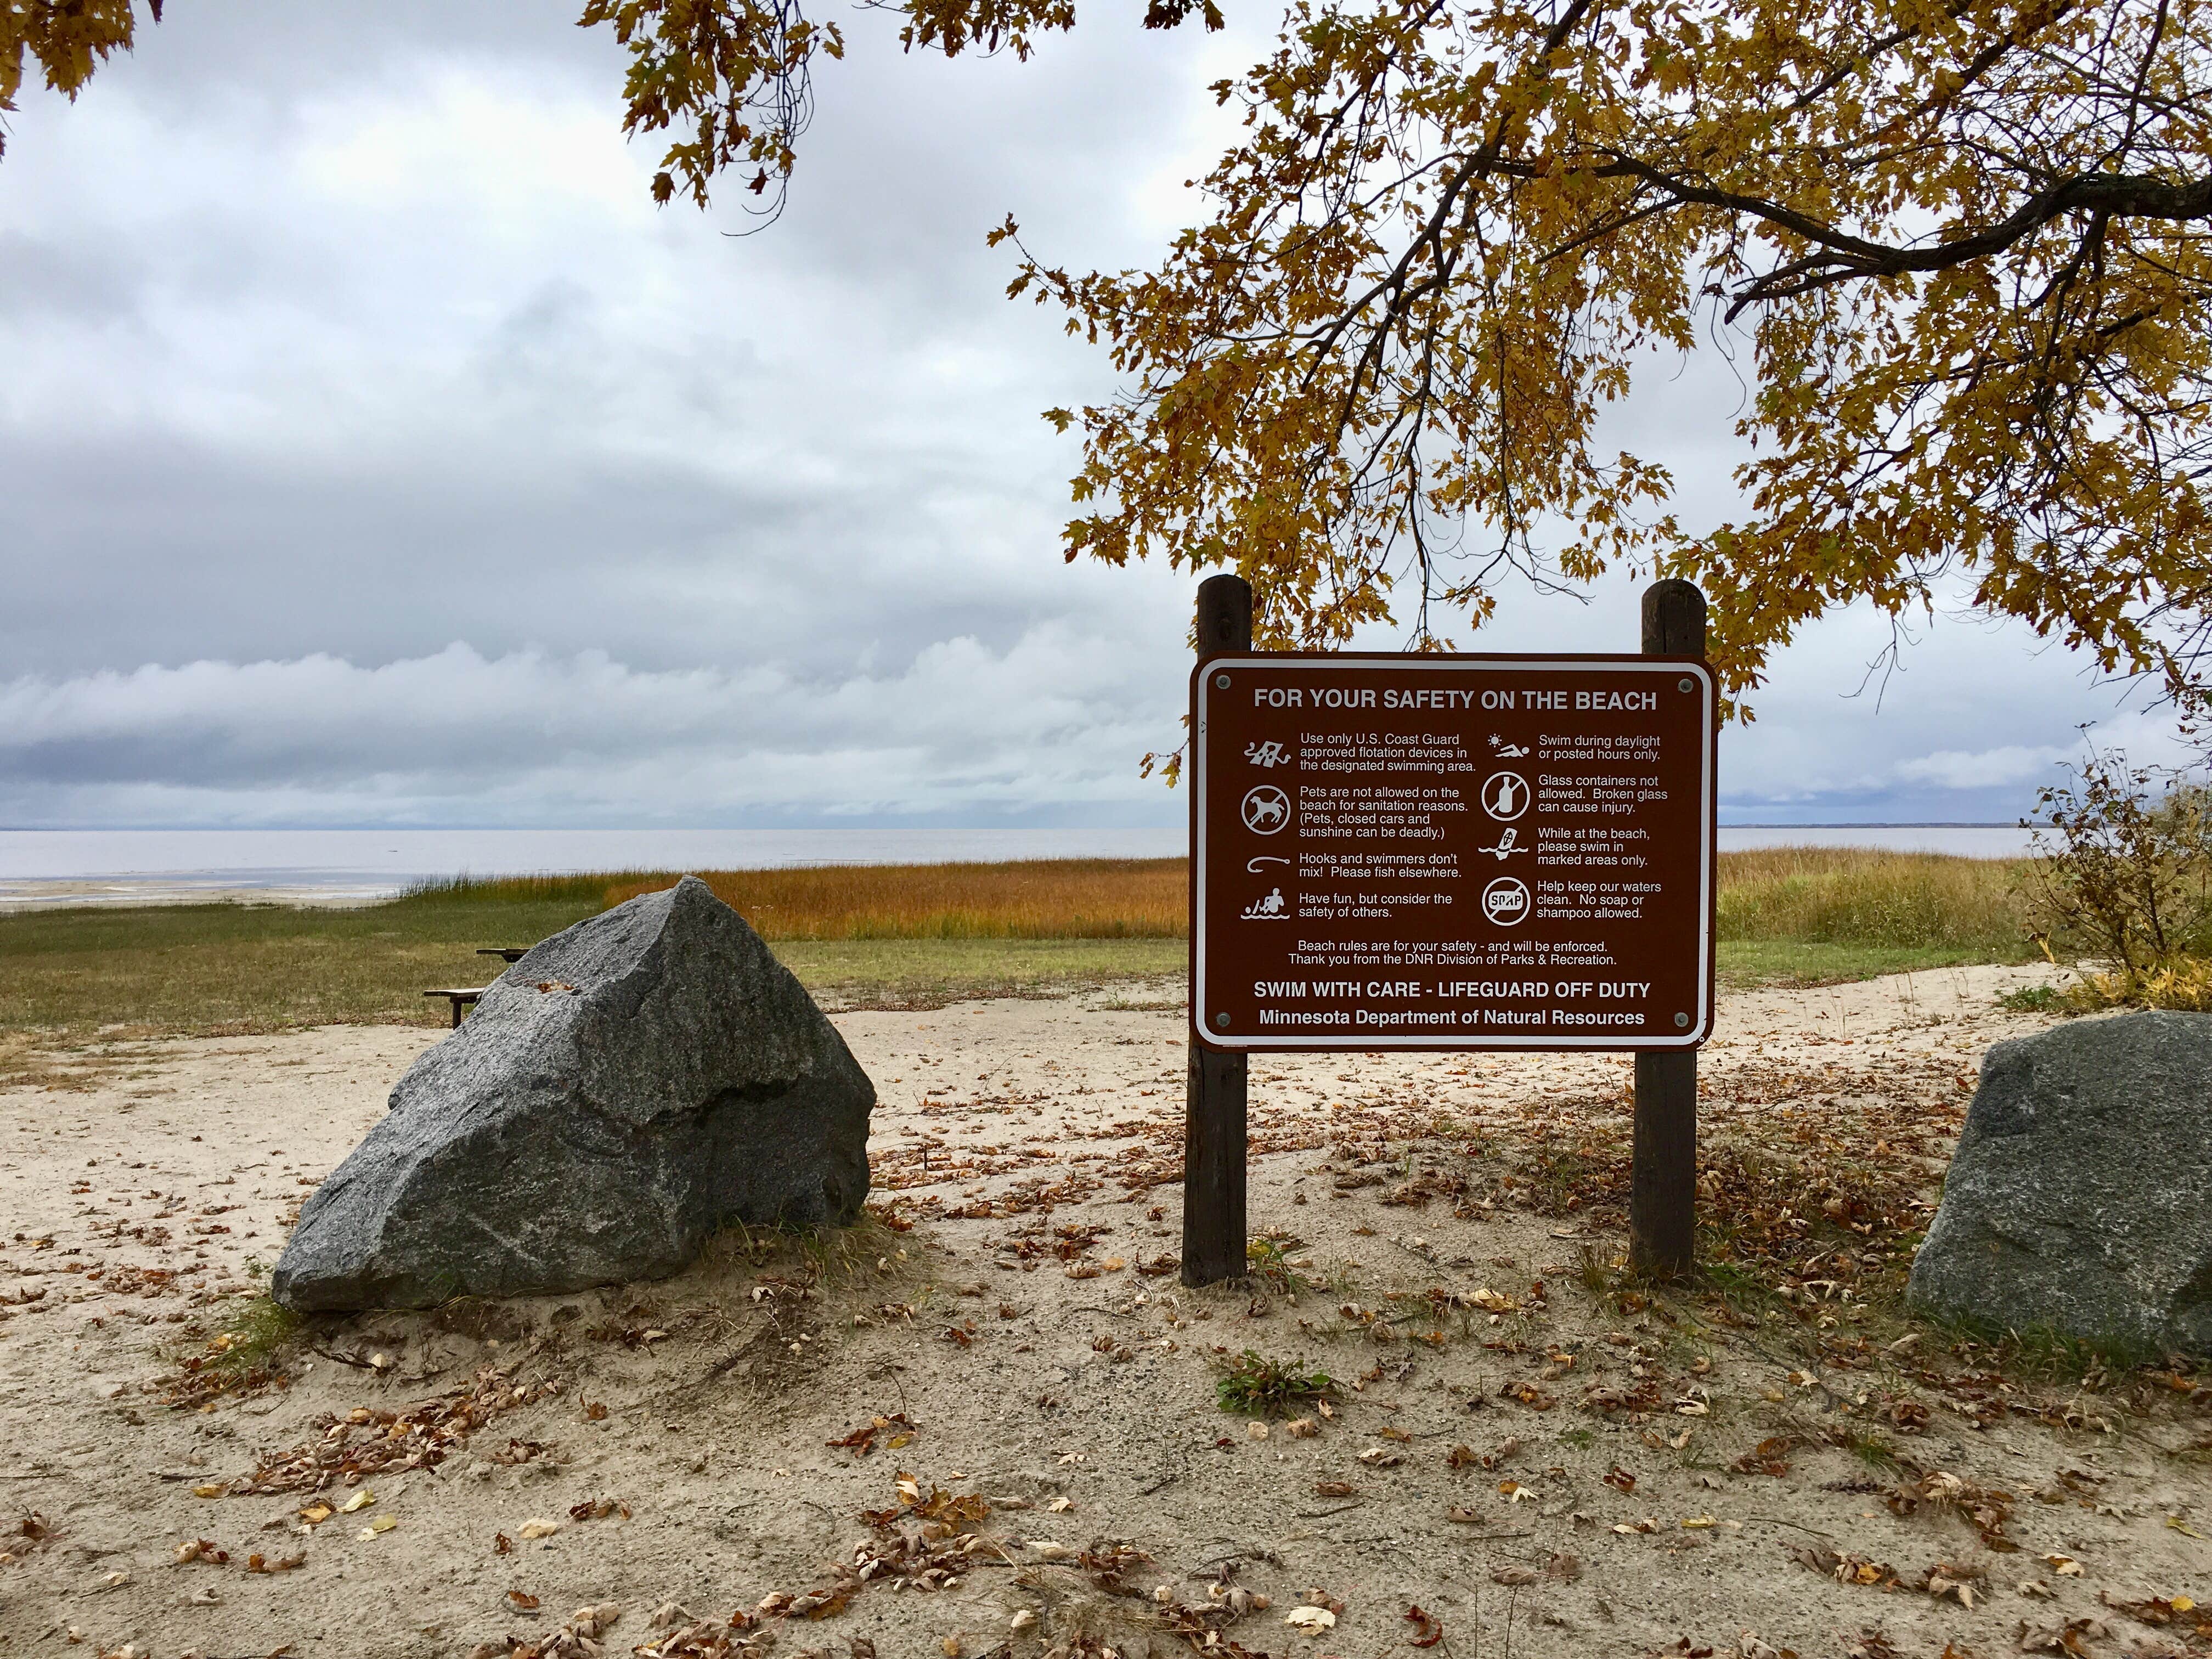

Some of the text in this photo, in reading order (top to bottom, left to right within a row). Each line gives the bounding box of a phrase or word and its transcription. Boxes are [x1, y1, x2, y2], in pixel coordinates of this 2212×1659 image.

[1255, 688, 1656, 710] FOR YOUR SAFETY ON THE BEACH
[1301, 732, 1459, 747] Use only U.S. Coast Guard
[1539, 734, 1661, 749] Swim during daylight
[1300, 746, 1467, 760] approved flotation devices in
[1538, 748, 1660, 763] or posted hours only.
[1300, 759, 1476, 774] the designated swimming area.
[1538, 774, 1658, 786] Glass containers not
[1300, 786, 1459, 798] Pets are not allowed on the
[1538, 788, 1668, 802] allowed. Broken glass
[1300, 799, 1468, 811] beach for sanitation reasons.
[1538, 801, 1635, 815] can cause injury.
[1300, 812, 1430, 826] (Pets, closed cars and
[1299, 826, 1444, 840] sunshine can be deadly.)
[1538, 827, 1650, 840] While at the beach,
[1538, 840, 1623, 854] please swim in
[1300, 853, 1458, 864] Hooks and swimmers don't
[1538, 854, 1648, 868] marked areas only.
[1299, 866, 1462, 878] mix! Please fish elsewhere.
[1537, 880, 1661, 894] Help keep our waters
[1299, 893, 1452, 906] Have fun, but consider the
[1537, 894, 1645, 907] clean. No soap or
[1299, 906, 1392, 919] safety of others.
[1537, 906, 1643, 921] shampoo allowed.
[1298, 940, 1335, 951] Beach
[1339, 940, 1368, 951] rules
[1371, 943, 1390, 951] are
[1393, 940, 1410, 951] for
[1412, 943, 1438, 954] your
[1441, 940, 1477, 954] safety
[1488, 940, 1510, 952] and
[1513, 940, 1532, 951] will
[1535, 940, 1550, 952] be
[1553, 940, 1607, 952] enforced.
[1288, 953, 1617, 967] Thank you from the DNR Division of Parks & Recreation.
[1254, 981, 1306, 997] SWIM
[1312, 981, 1361, 997] WITH
[1367, 981, 1420, 997] CARE
[1438, 981, 1549, 997] LIFEGUARD
[1555, 981, 1593, 998] OFF
[1599, 982, 1651, 998] DUTY
[1260, 1009, 1645, 1028] Minnesota Department of Natural Resources
